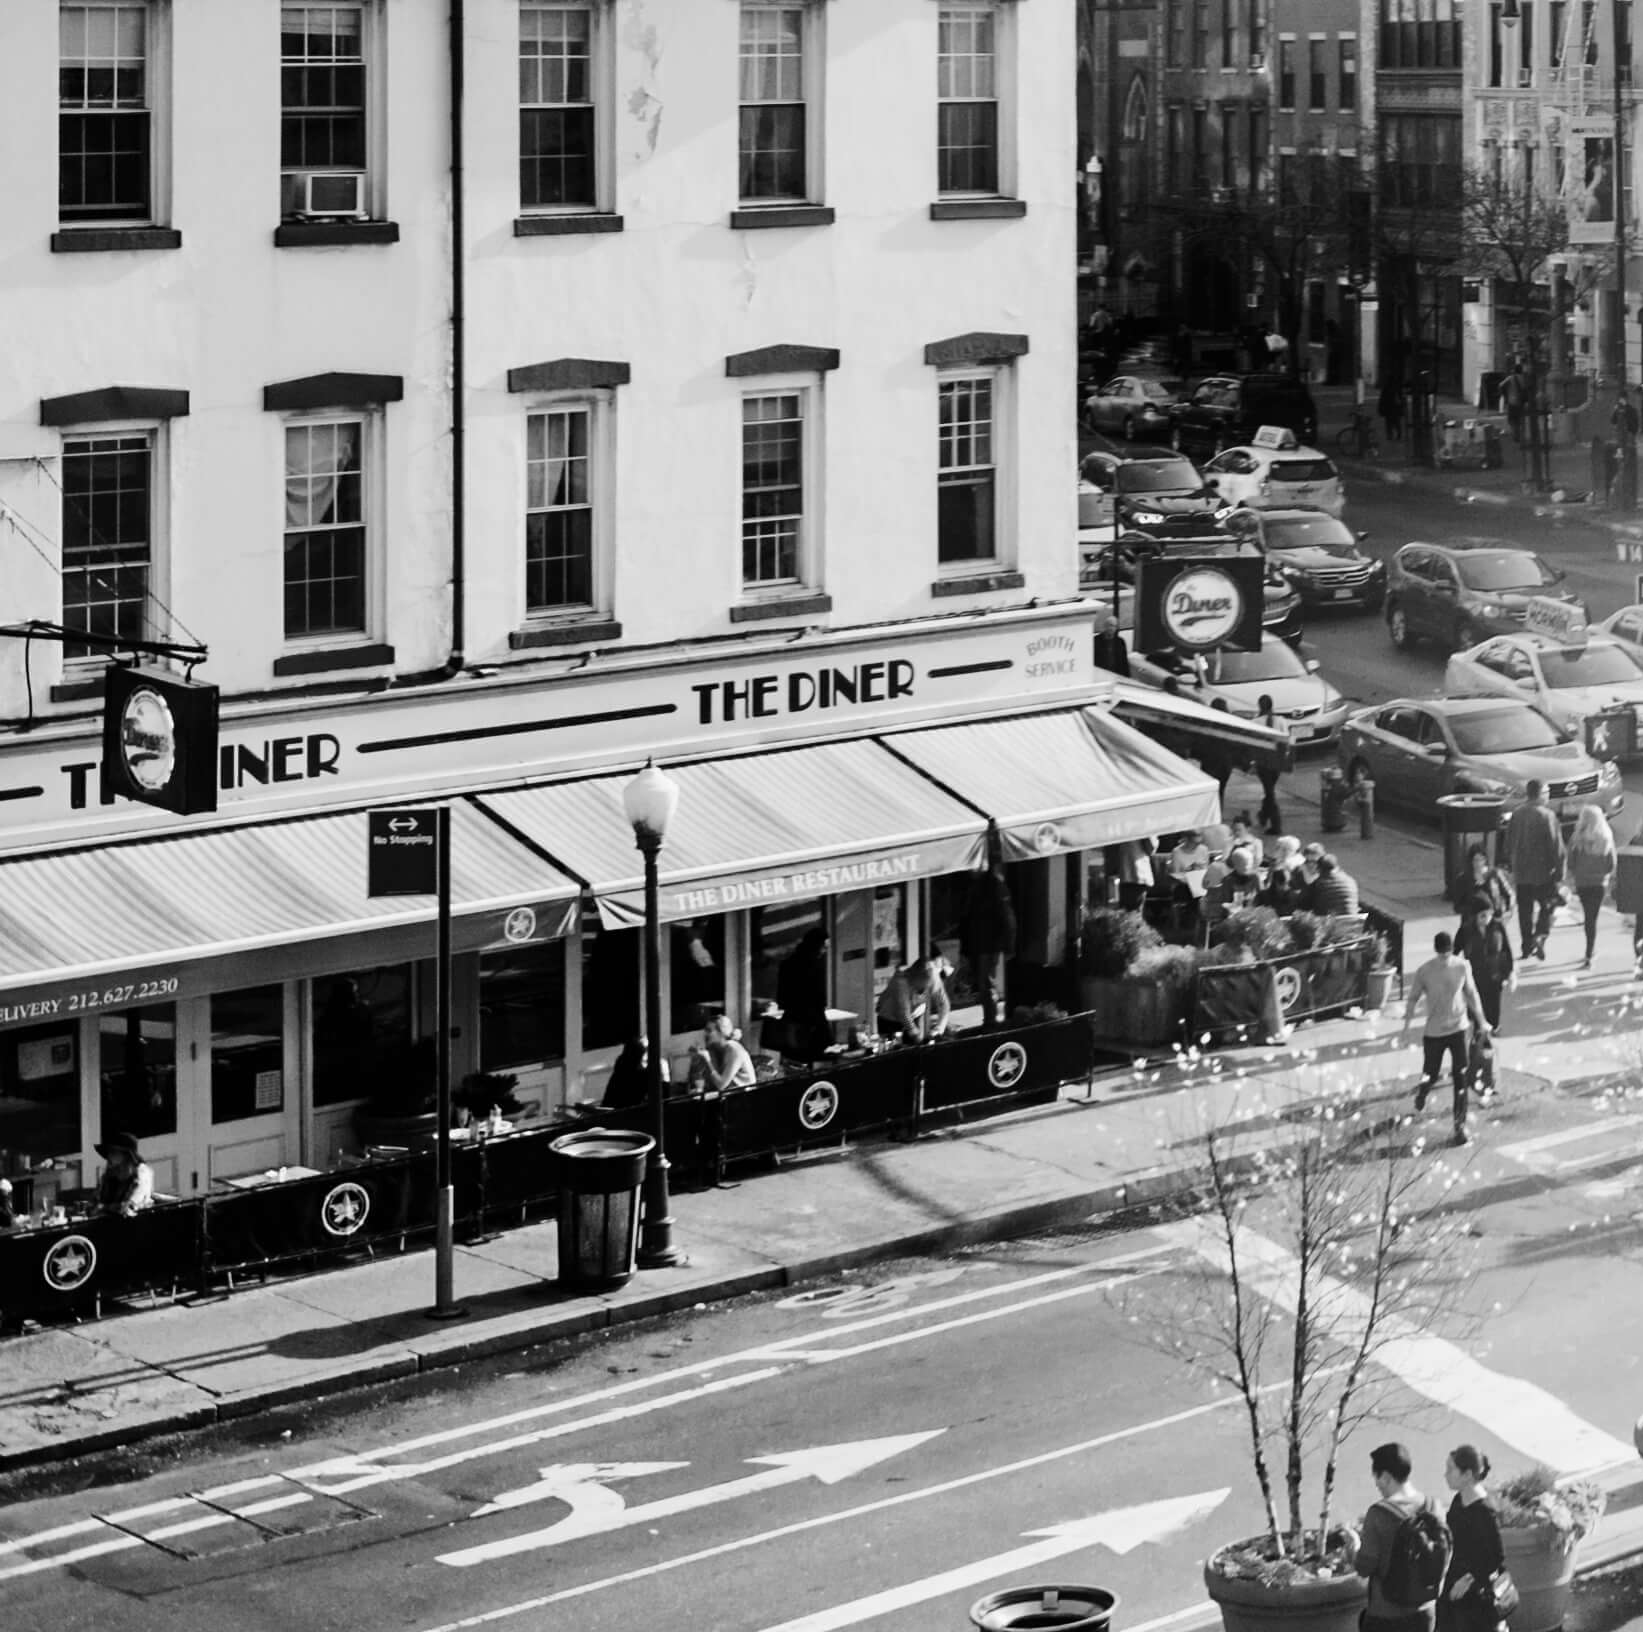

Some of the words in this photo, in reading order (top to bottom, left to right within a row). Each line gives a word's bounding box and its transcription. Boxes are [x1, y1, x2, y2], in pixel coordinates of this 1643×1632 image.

[1629, 544, 1643, 563] 14
[1171, 592, 1233, 617] Diner
[1026, 634, 1076, 657] BOOTH
[1024, 658, 1076, 680] SERVICE
[691, 674, 779, 725] THE
[787, 658, 916, 713] DINER
[220, 732, 341, 790] INER
[373, 835, 388, 845] No
[674, 889, 717, 913] THE
[721, 876, 786, 910] DINER
[791, 853, 920, 894] RESTAURANT
[0, 1000, 61, 1023] LIVERY
[69, 977, 179, 1011] 212.627.2230
